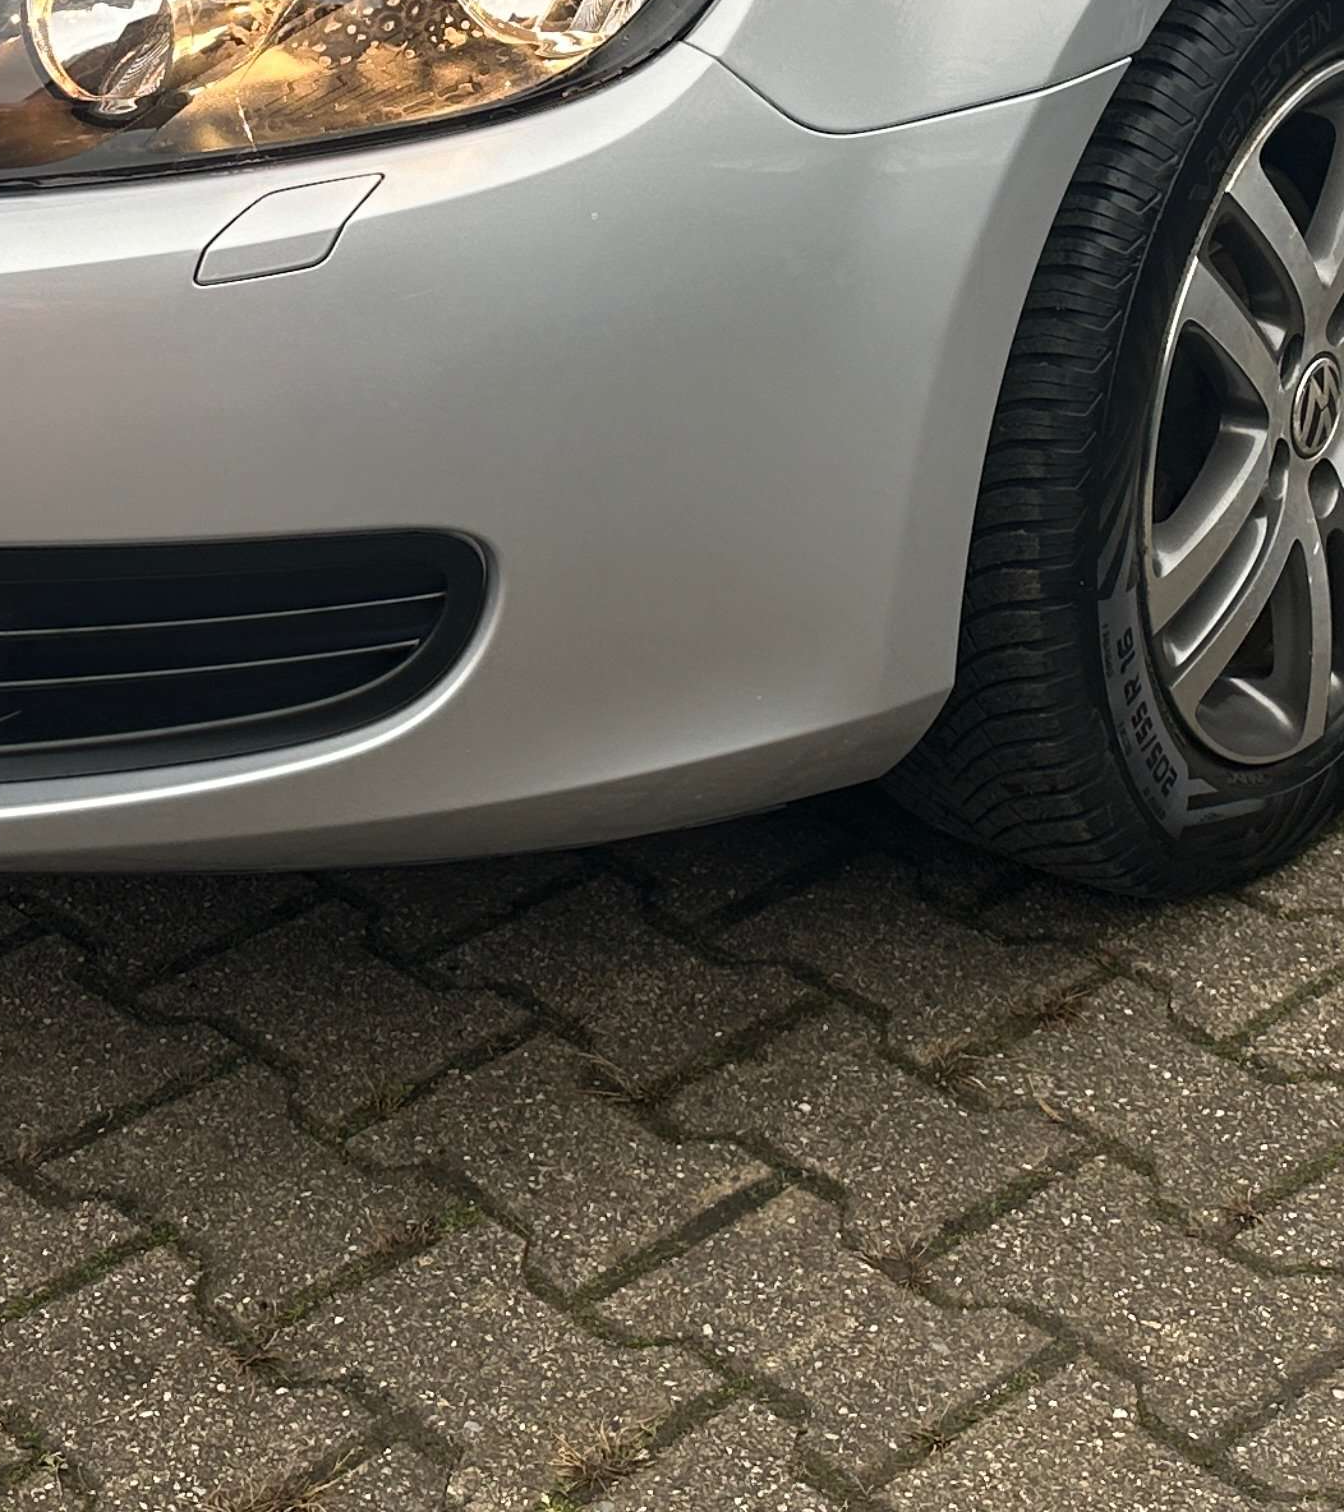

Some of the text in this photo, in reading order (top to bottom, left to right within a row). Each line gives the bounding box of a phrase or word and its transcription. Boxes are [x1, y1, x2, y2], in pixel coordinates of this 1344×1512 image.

[1116, 626, 1136, 675] 16
[1123, 674, 1142, 707] R
[1131, 700, 1179, 798] 205/55
